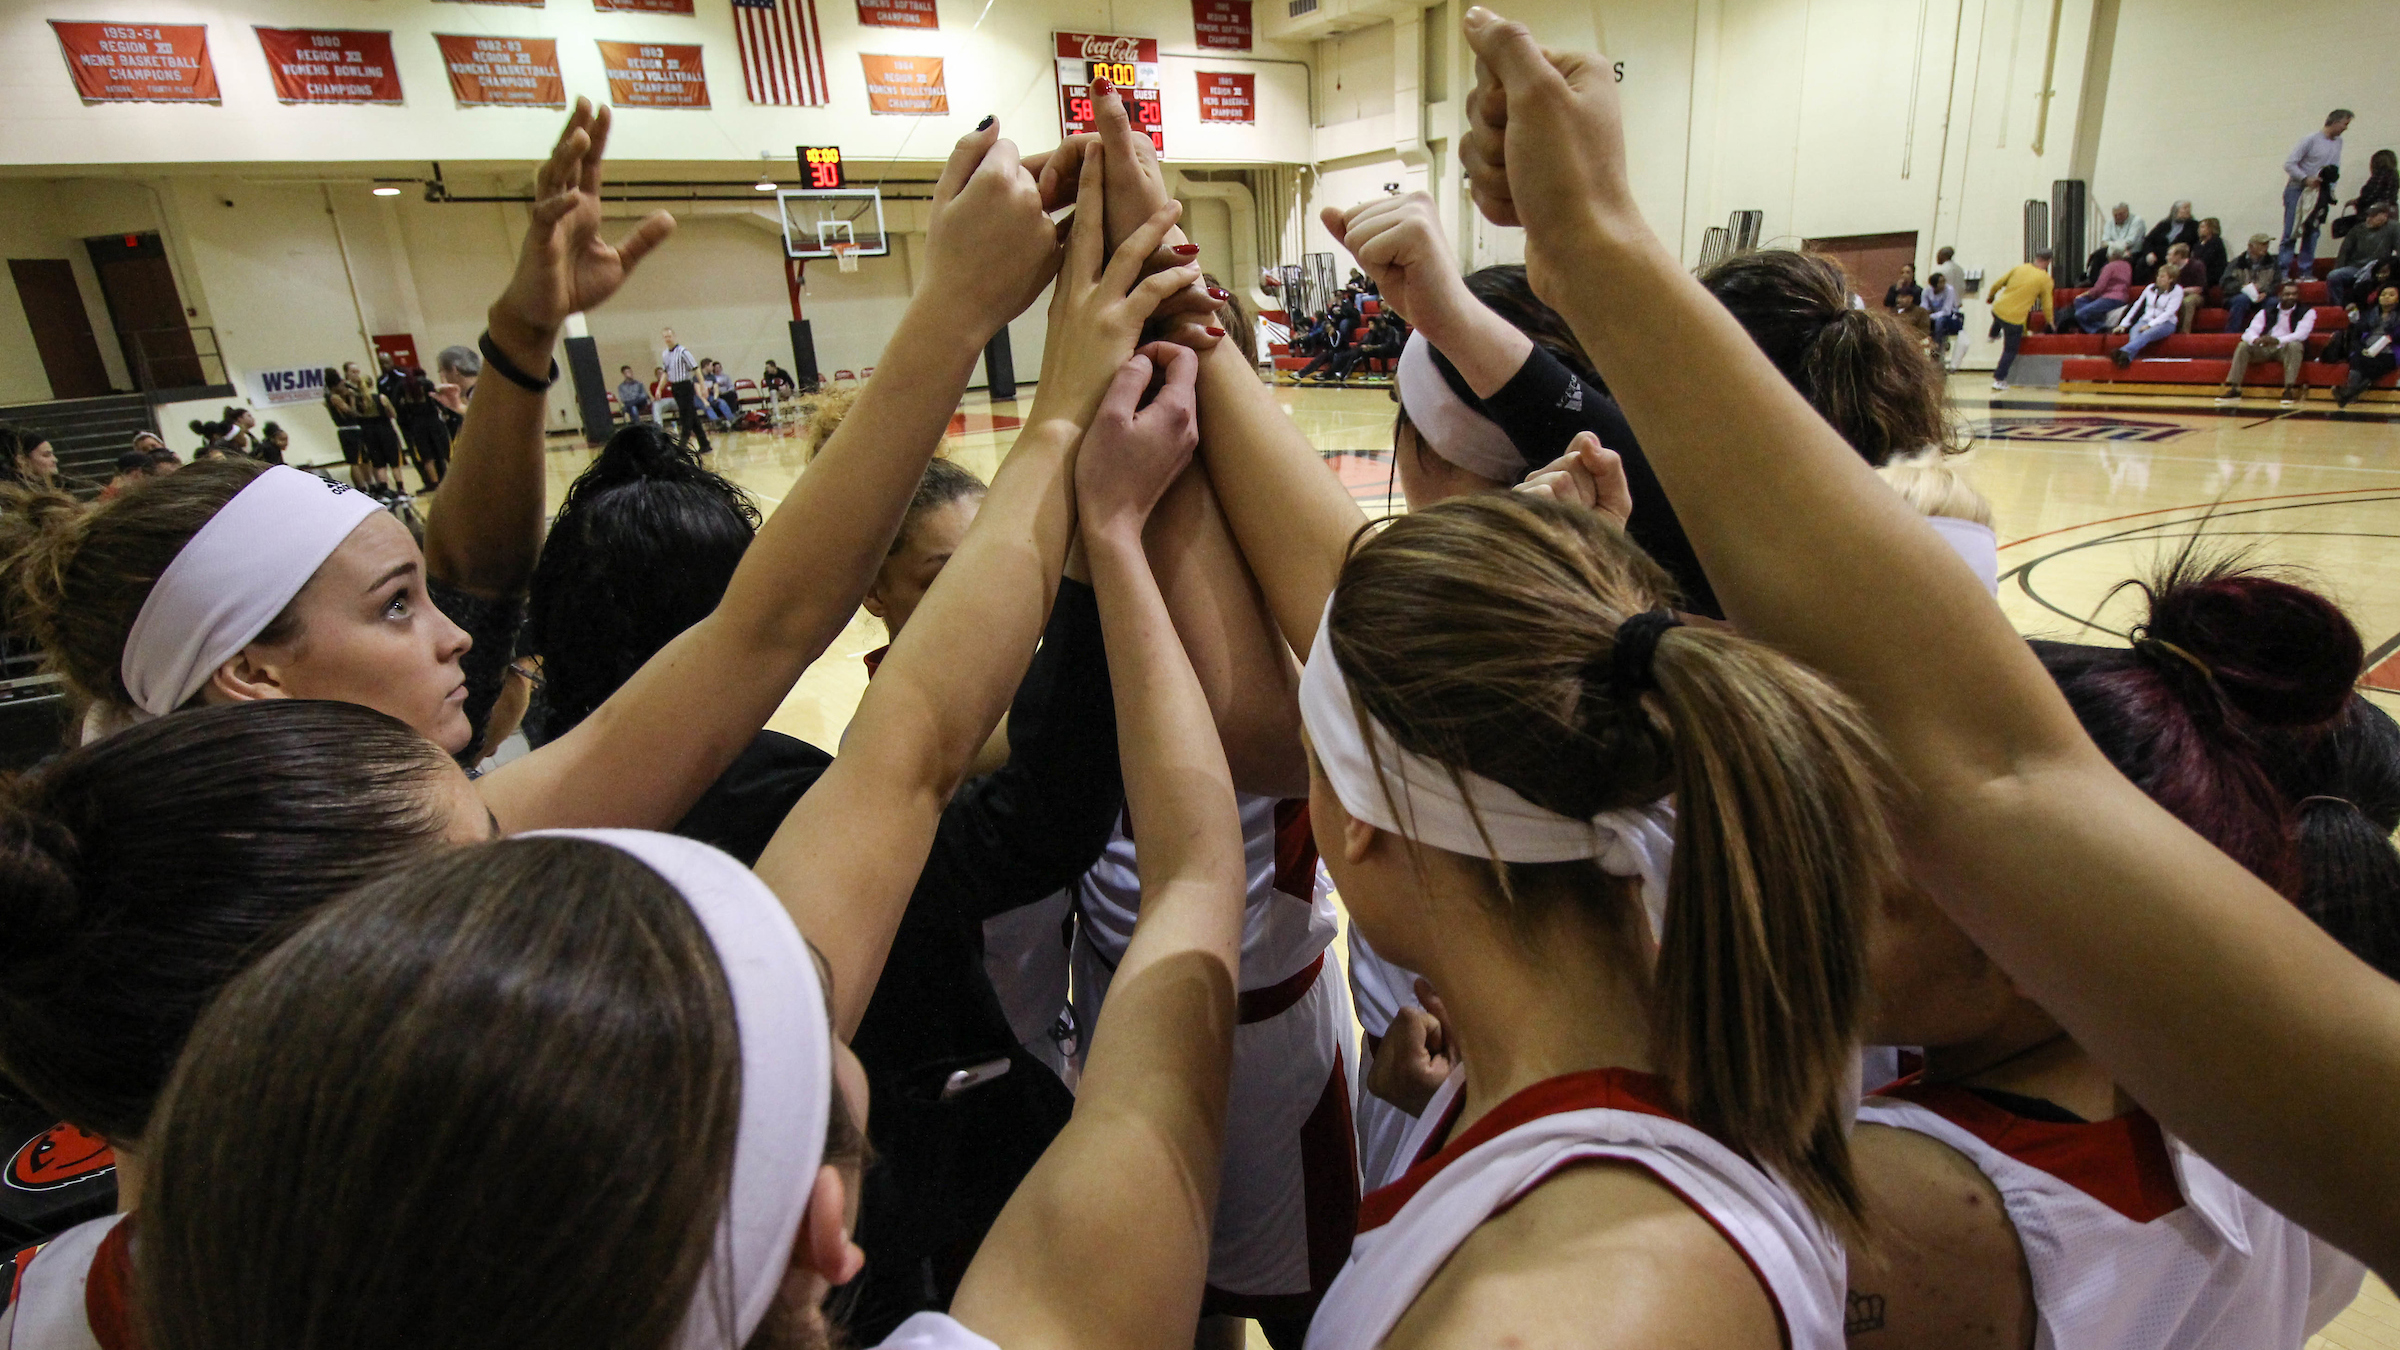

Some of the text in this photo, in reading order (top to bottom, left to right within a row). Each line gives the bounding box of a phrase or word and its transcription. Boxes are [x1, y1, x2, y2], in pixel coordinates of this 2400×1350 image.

[104, 28, 161, 41] 1953-54
[100, 41, 147, 54] REGION
[81, 55, 199, 68] MENS BASKETBALL
[297, 50, 339, 62] REGION
[473, 52, 510, 63] REGION
[628, 59, 662, 69] REGION
[110, 70, 181, 81] CHAMPIONS
[282, 65, 383, 78] WOMENS BOWLING
[495, 65, 557, 77] BASKETBALL
[646, 72, 704, 82] VOLLEYBALL
[1094, 62, 1135, 86] 10:00
[1613, 61, 1624, 83] S
[479, 77, 537, 88] CHAMPIONS
[633, 83, 683, 93] CHAMPIONS
[307, 84, 372, 96] CHAMPIONS
[901, 87, 945, 96] VOLLEYBALL
[1070, 86, 1087, 97] LMC
[1134, 90, 1157, 100] GUEST
[889, 99, 930, 108] CHAMPIONS
[1071, 98, 1095, 121] 58
[1139, 101, 1160, 123] 20
[807, 148, 839, 163] 10:00
[811, 162, 839, 187] 30
[262, 369, 323, 393] WSJM
